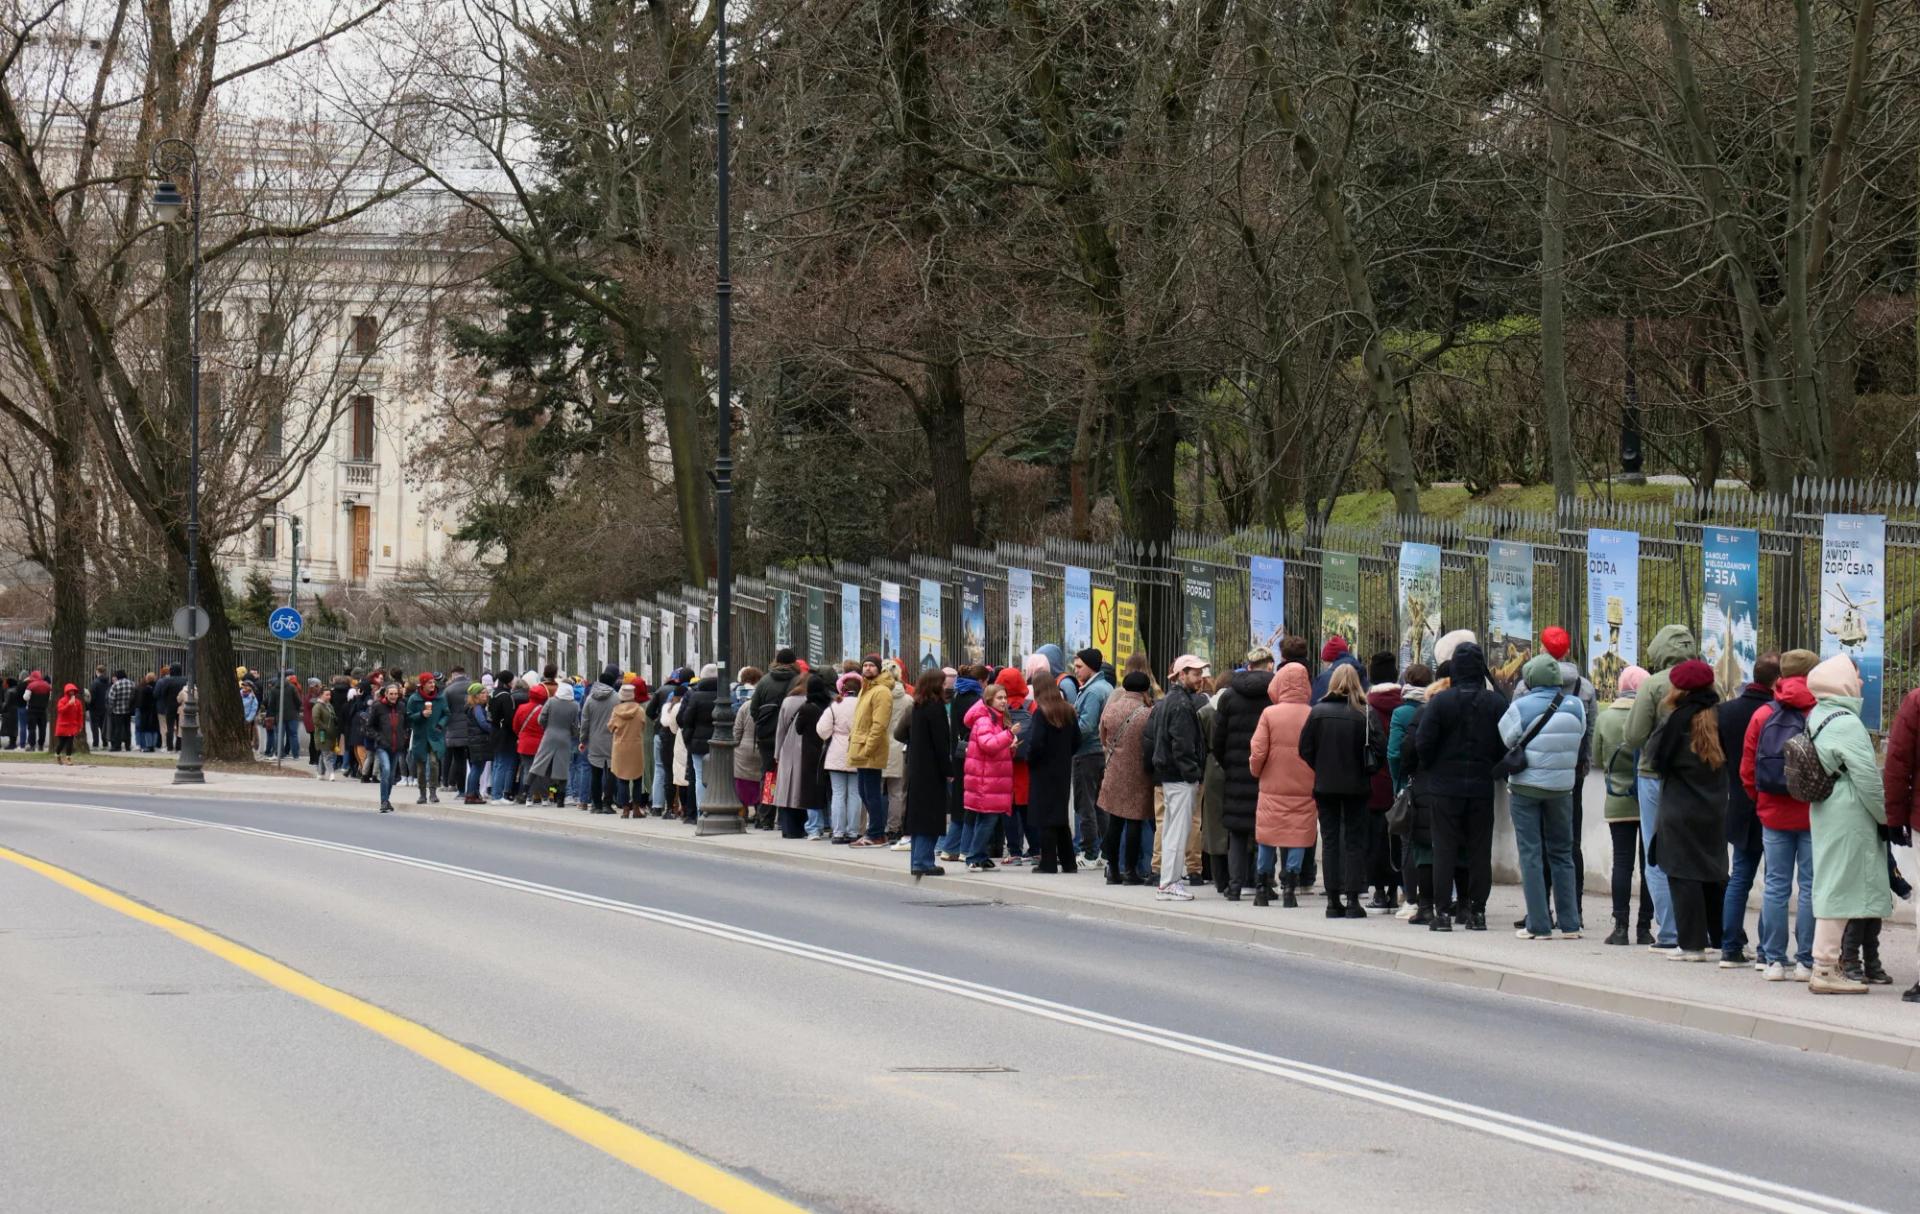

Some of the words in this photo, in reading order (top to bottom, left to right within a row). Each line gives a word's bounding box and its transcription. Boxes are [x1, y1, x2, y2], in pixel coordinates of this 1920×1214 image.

[1705, 551, 1729, 561] SAMOLOT
[1825, 549, 1852, 561] AW101
[1589, 560, 1617, 575] ODRA
[1825, 561, 1874, 576] ZOP/CSAR
[1400, 576, 1431, 592] PIORUN
[1490, 571, 1525, 587] JAVELIN
[1705, 568, 1737, 586] F-35A
[1186, 584, 1211, 600] POPRAD
[1252, 588, 1272, 602] PILICA
